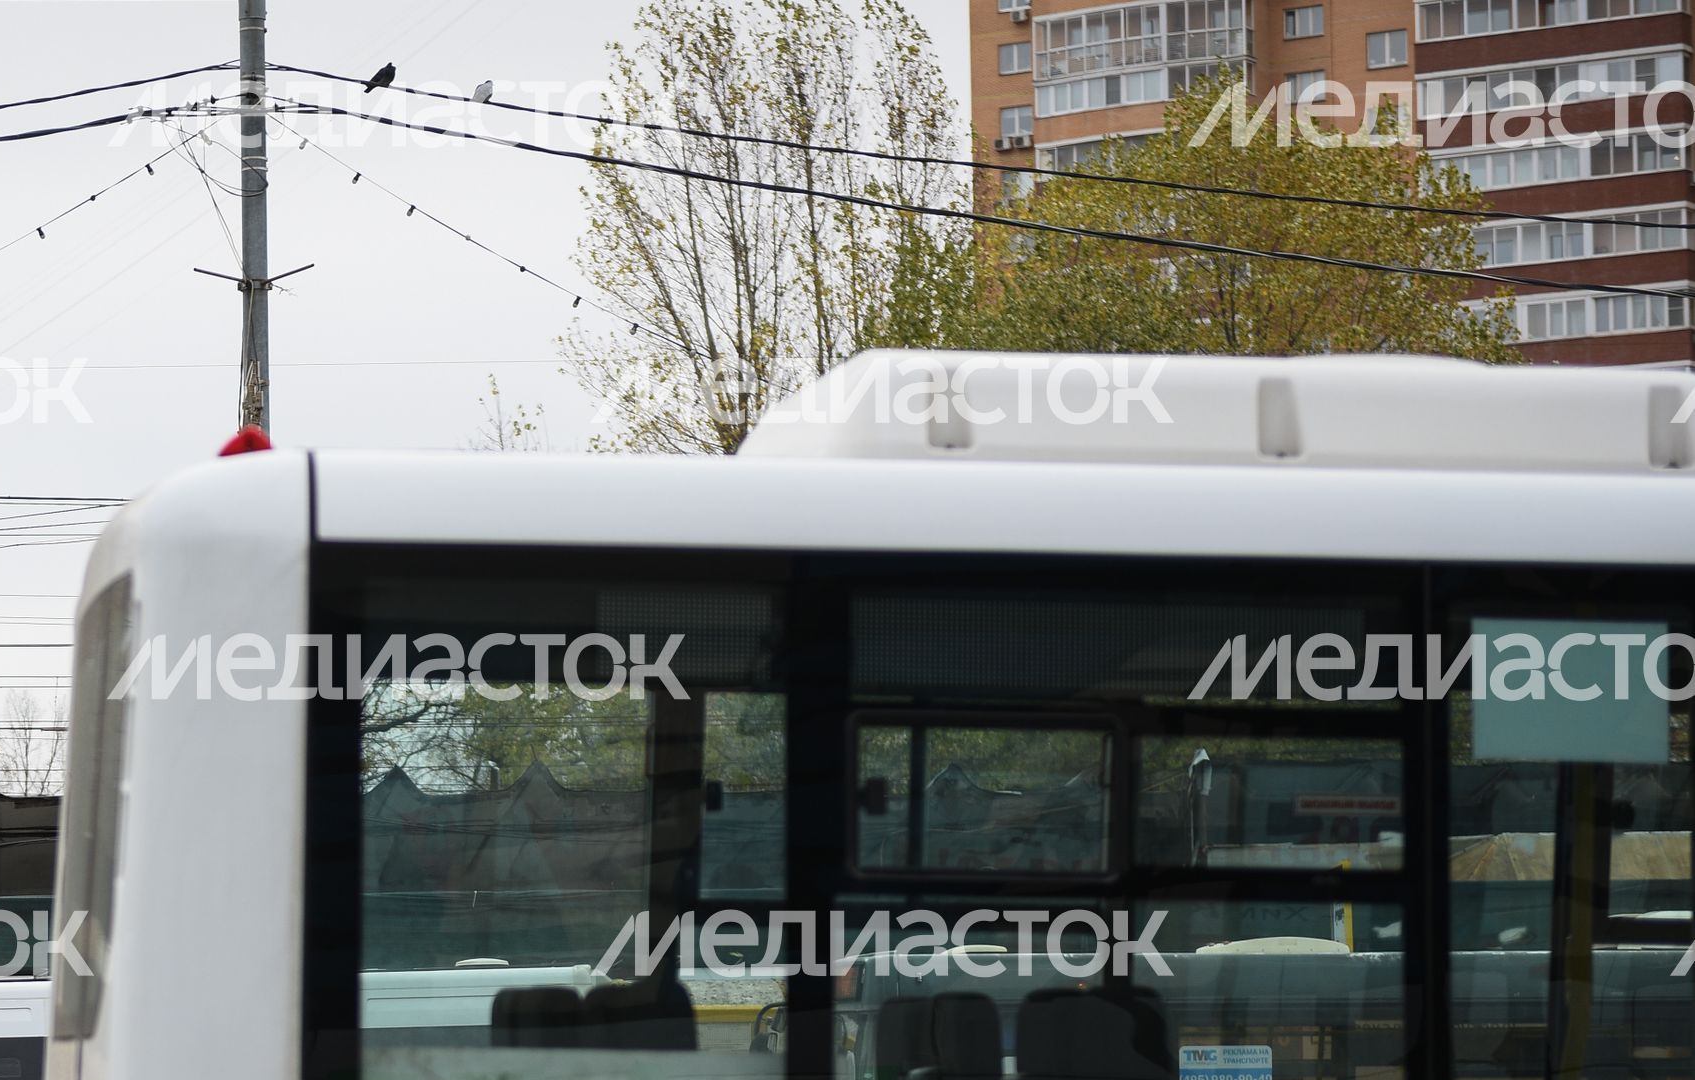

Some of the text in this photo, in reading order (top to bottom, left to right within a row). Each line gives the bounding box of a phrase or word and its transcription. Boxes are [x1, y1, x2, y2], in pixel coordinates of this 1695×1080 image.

[1222, 1047, 1269, 1056] РЕКЛАМА НА
[1222, 1056, 1268, 1065] ТРАНСПОРТЕ
